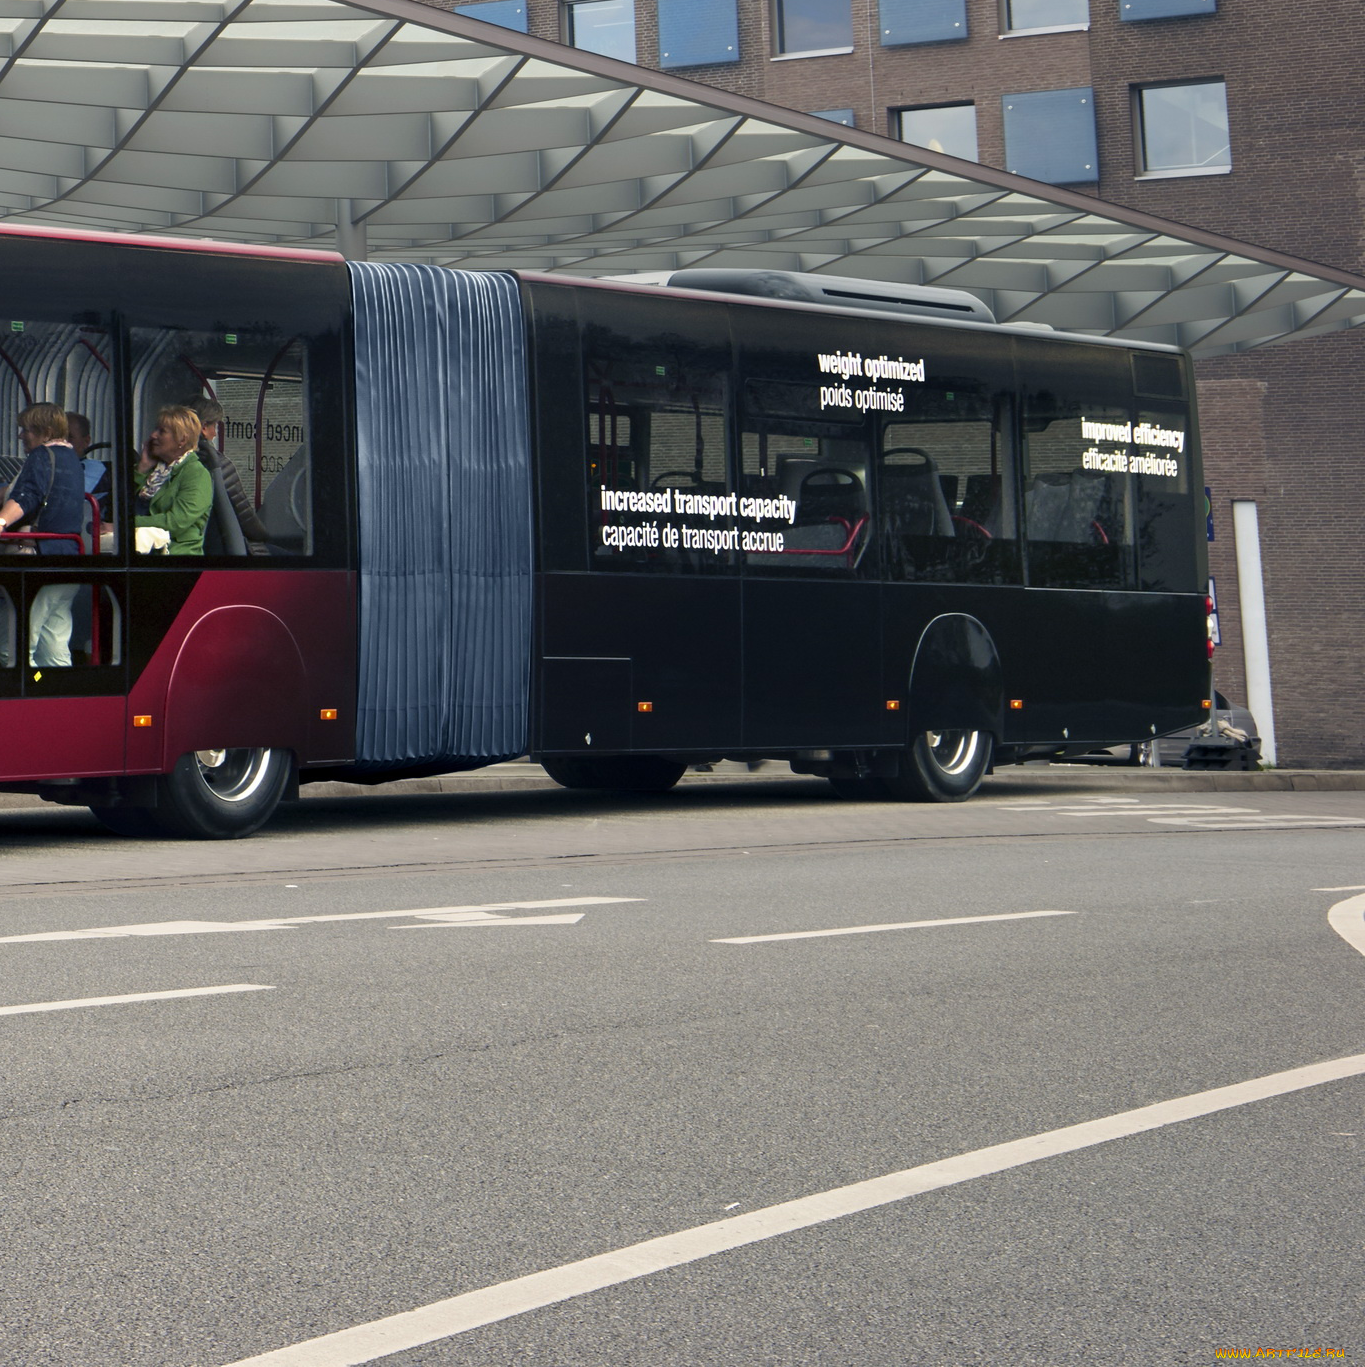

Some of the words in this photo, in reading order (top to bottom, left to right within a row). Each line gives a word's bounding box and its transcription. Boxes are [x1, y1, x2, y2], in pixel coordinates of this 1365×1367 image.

[817, 350, 863, 380] weight
[864, 355, 925, 383] optimized
[820, 382, 853, 411] poids
[855, 386, 905, 414] optimisé
[1081, 416, 1132, 444] improved
[1133, 422, 1184, 453] efficiency
[1082, 448, 1128, 473] efficacité
[1129, 452, 1178, 477] améliorée
[601, 485, 671, 514] increased
[674, 489, 737, 520] transport
[740, 494, 796, 525] capacity
[602, 521, 659, 552] capacité
[662, 523, 679, 548] de
[682, 524, 739, 555] transport
[741, 530, 785, 553] accrue
